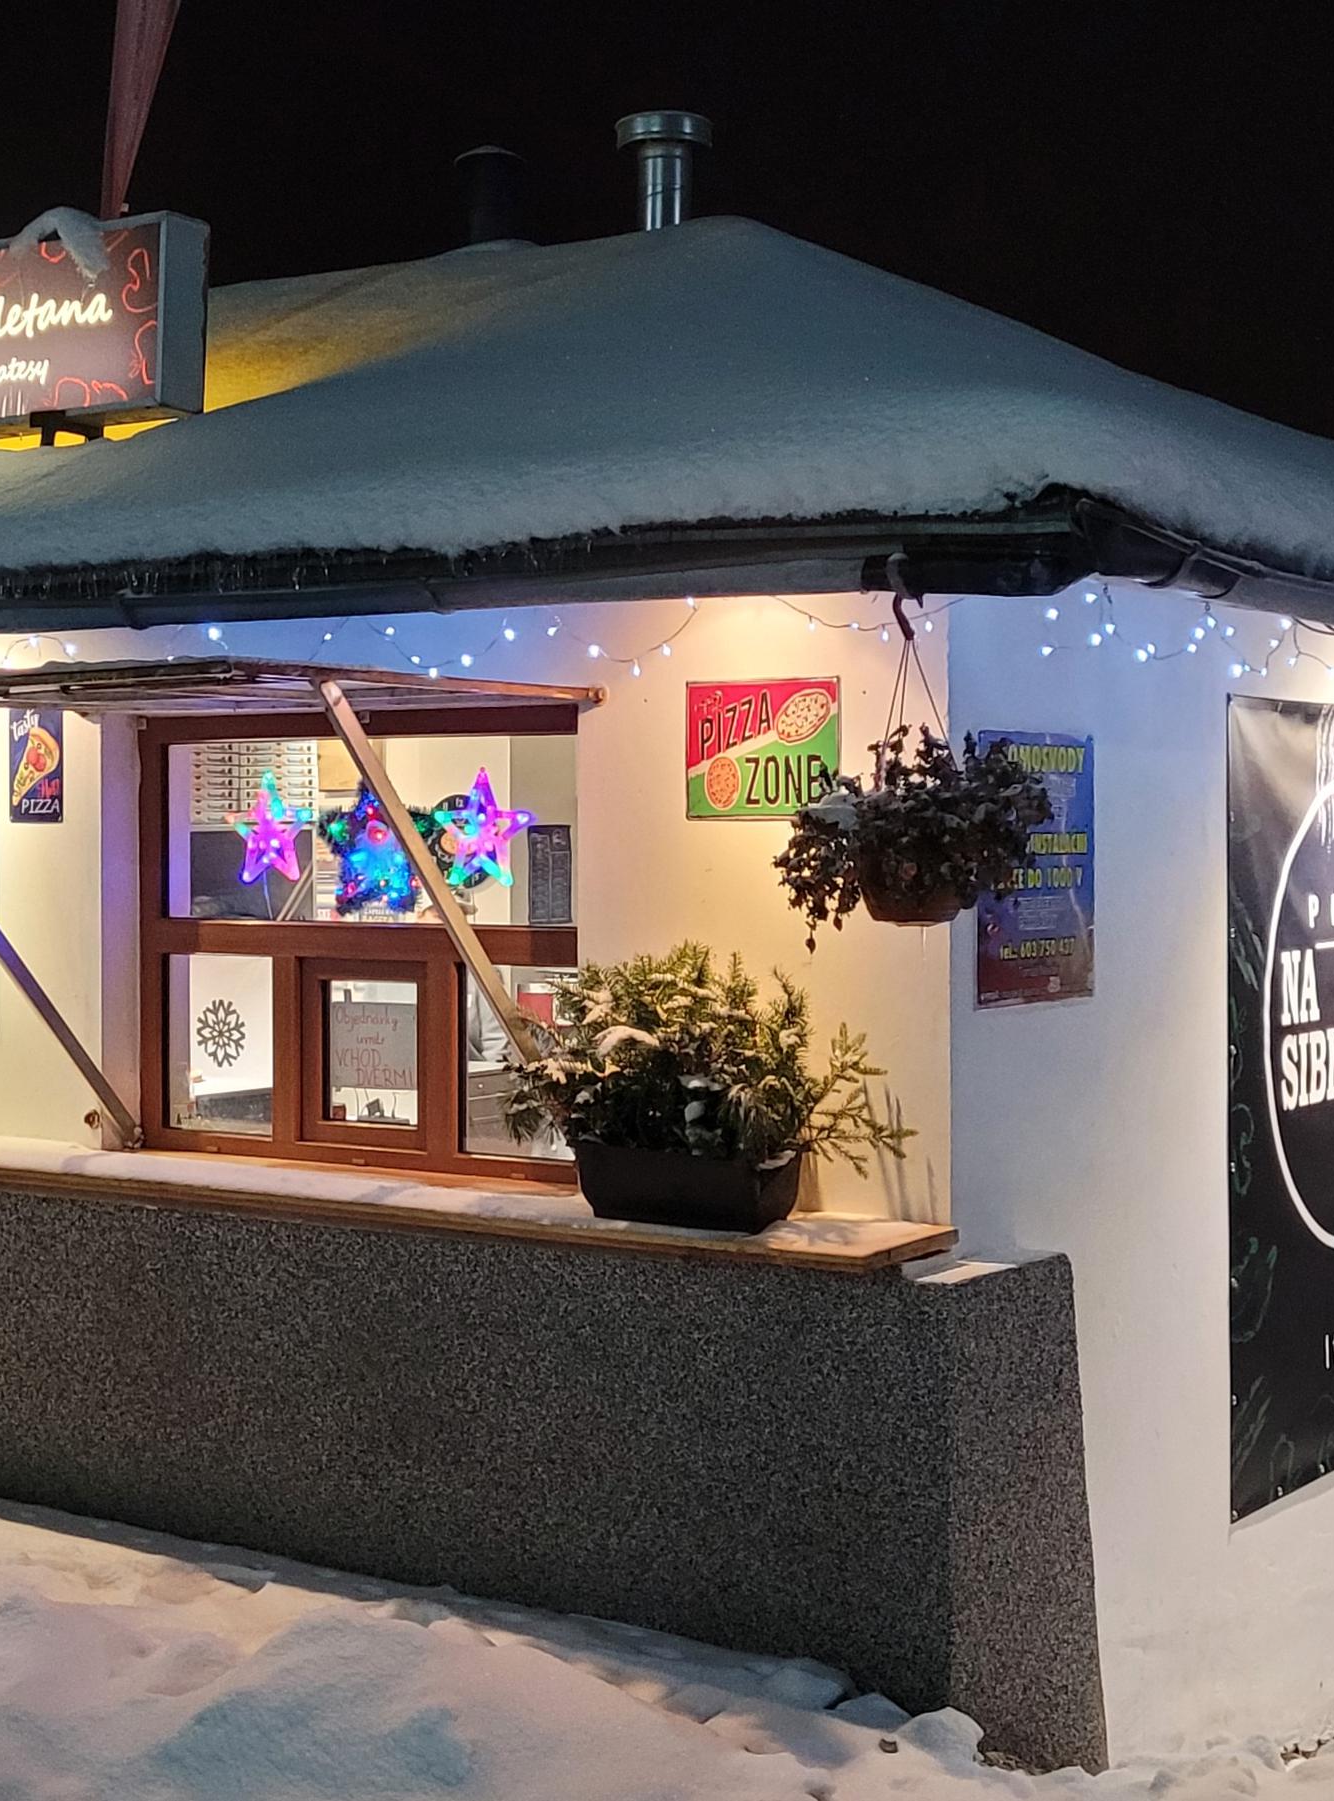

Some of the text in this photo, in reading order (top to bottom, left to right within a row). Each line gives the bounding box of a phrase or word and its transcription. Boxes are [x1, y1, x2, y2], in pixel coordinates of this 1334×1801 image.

[699, 690, 774, 761] PIZZA
[21, 798, 61, 815] PIZZA
[744, 754, 822, 806] ZONE
[1281, 948, 1320, 1027] NA
